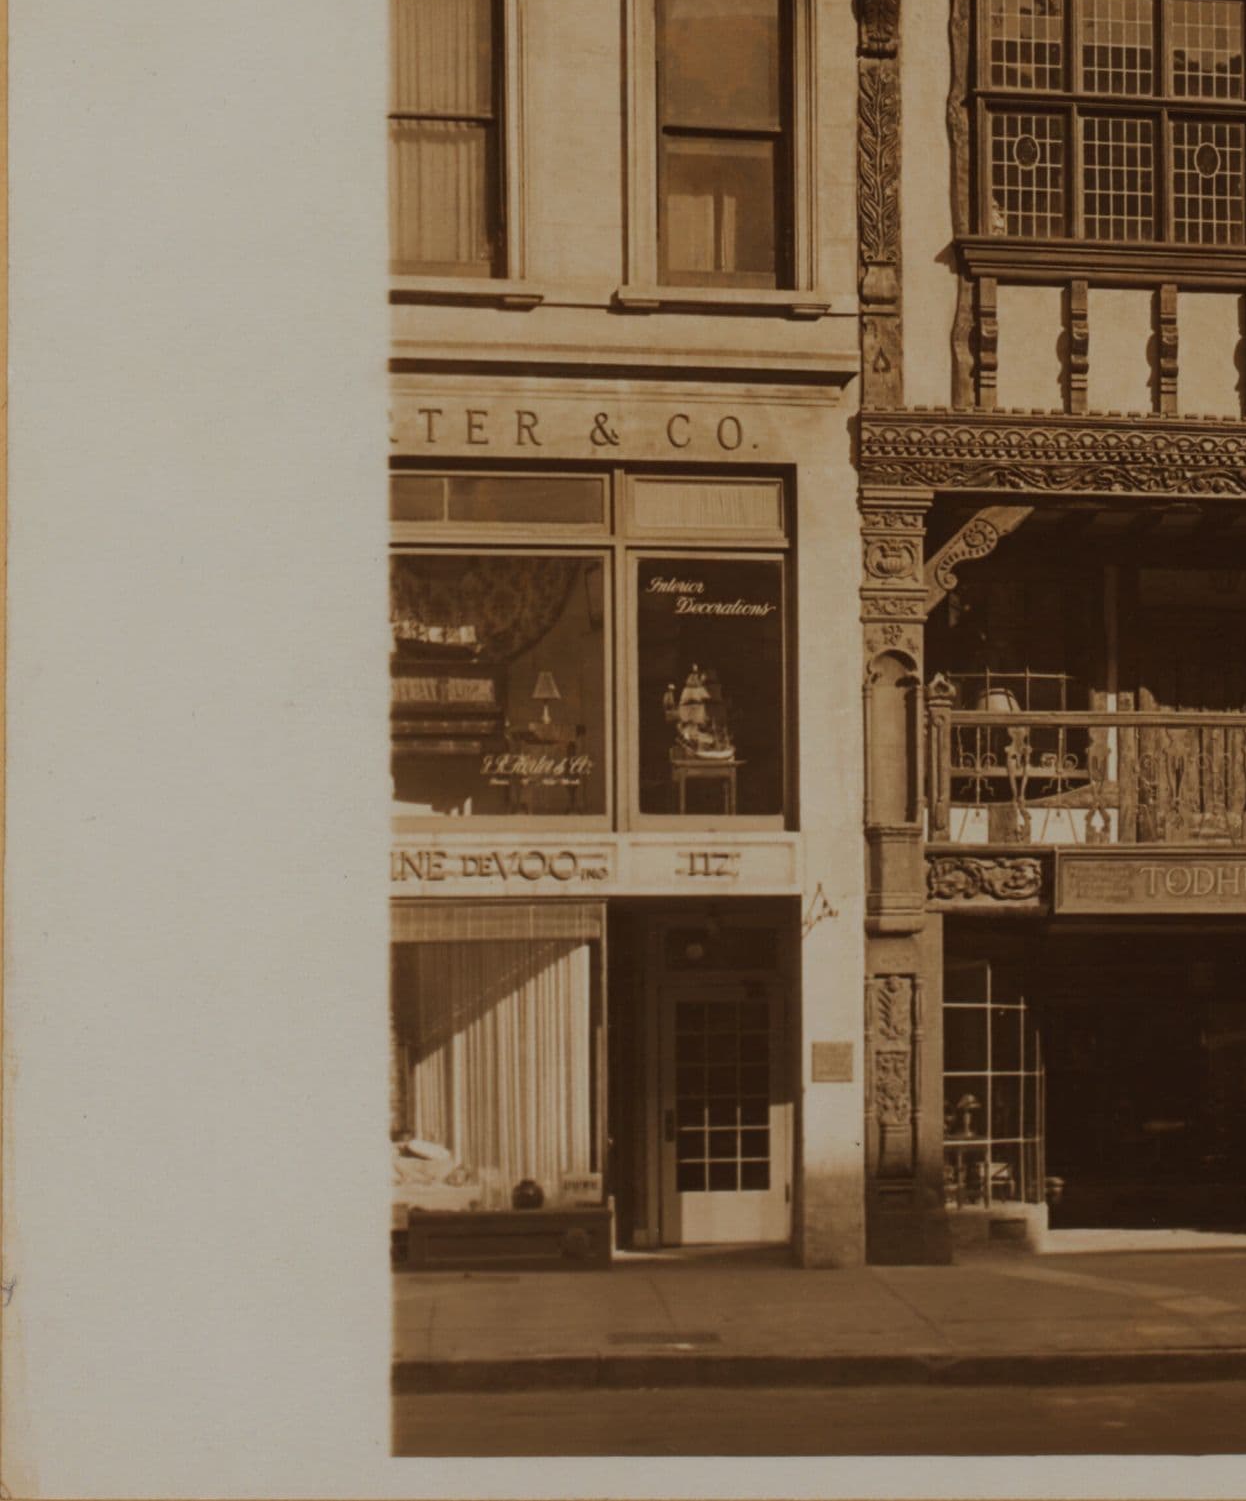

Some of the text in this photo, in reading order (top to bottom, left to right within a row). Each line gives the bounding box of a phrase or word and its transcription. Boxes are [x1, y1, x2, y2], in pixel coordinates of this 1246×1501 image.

[590, 411, 620, 447] &
[666, 413, 760, 451] CO.
[645, 576, 705, 594] Interior
[674, 596, 777, 616] Decorations
